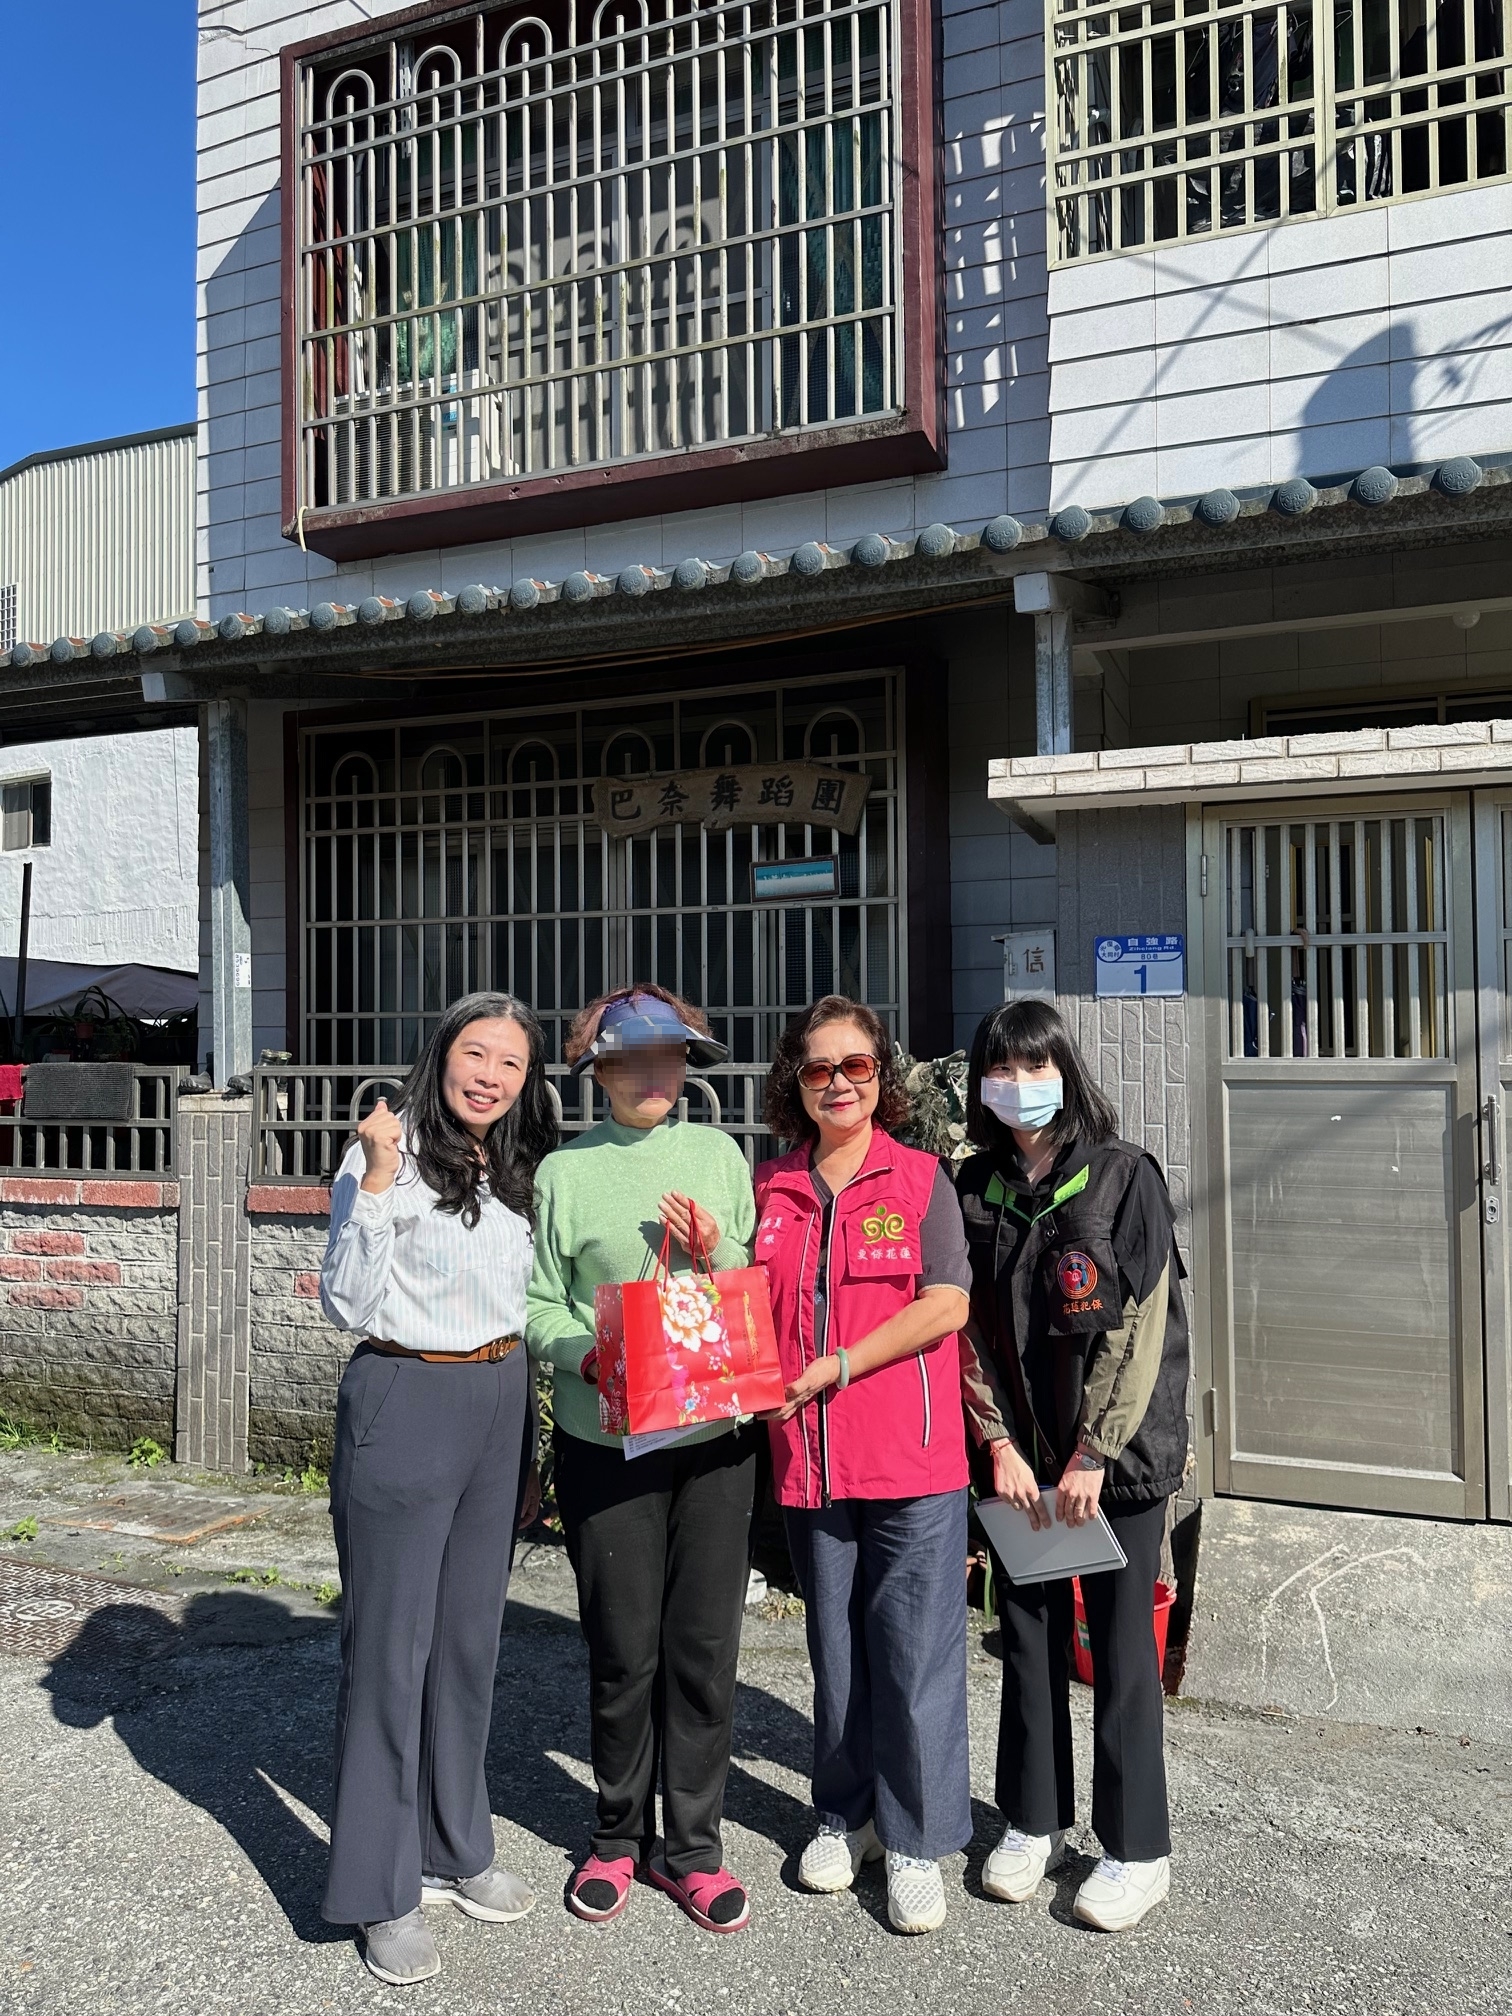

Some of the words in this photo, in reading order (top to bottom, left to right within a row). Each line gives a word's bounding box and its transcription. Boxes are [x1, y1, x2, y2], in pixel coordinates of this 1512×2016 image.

[610, 774, 847, 820] 巴奈舞蹈團
[1127, 936, 1178, 947] 自強路
[1023, 946, 1045, 974] 信
[1133, 965, 1147, 994] 1
